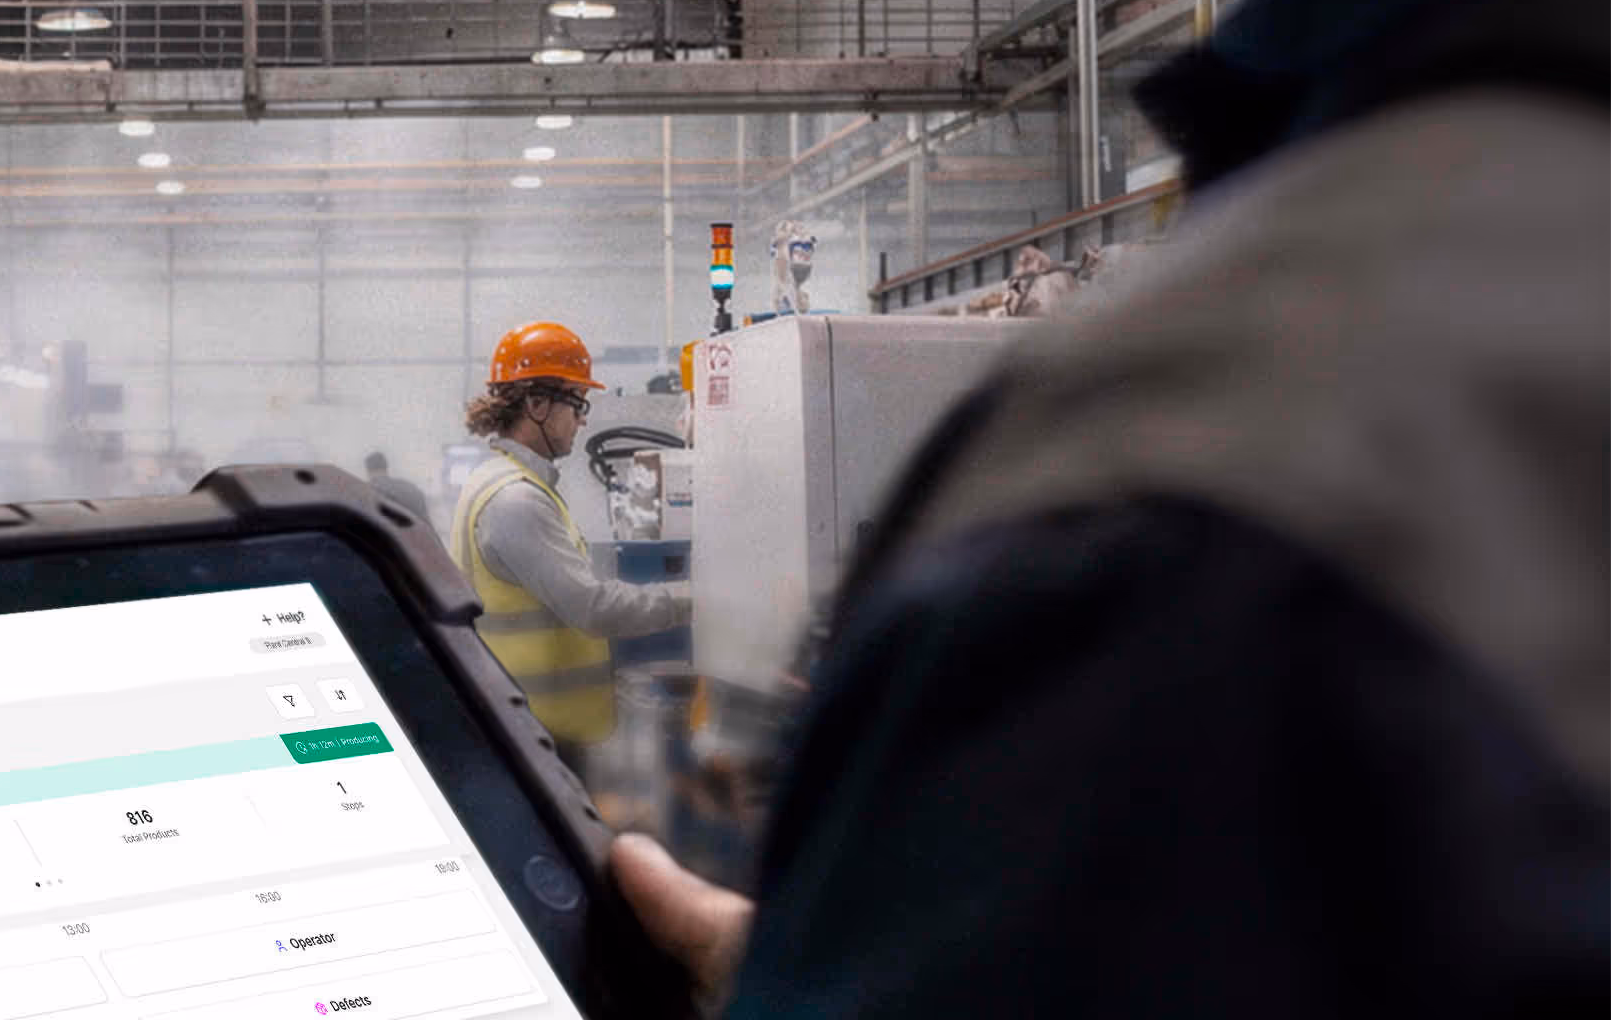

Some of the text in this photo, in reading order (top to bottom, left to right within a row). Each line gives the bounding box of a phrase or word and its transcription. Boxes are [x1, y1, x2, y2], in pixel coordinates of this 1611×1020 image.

[276, 611, 306, 625] Help?
[337, 781, 347, 795] 1
[340, 800, 364, 812] Stops
[126, 809, 153, 826] 816
[122, 827, 179, 845] Total Products
[434, 861, 460, 876] 19:00
[255, 891, 281, 905] 16:00
[62, 922, 90, 937] 13:00
[289, 931, 336, 951] Operator
[329, 995, 372, 1014] Defects
